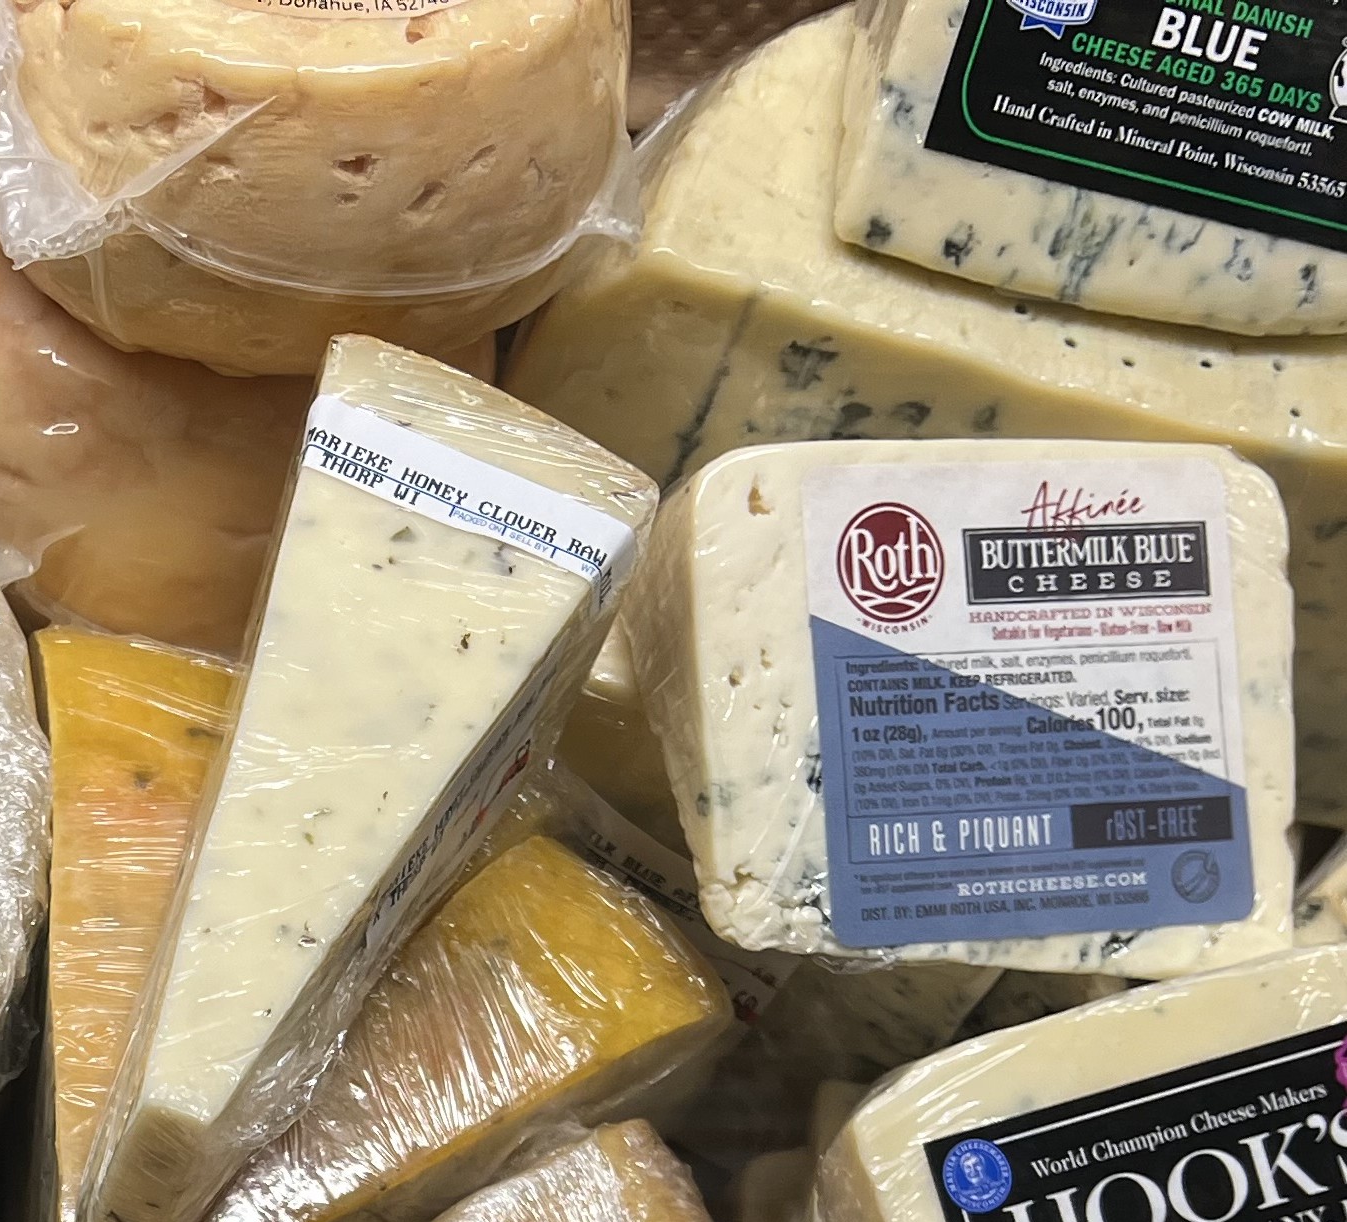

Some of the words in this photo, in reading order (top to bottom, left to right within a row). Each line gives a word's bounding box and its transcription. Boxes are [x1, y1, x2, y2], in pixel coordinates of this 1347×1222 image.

[1152, 6, 1269, 71] BLUE
[1233, 4, 1314, 39] DANISH
[1039, 51, 1118, 85] Ingredients:
[1119, 73, 1178, 99] Cultured
[1177, 90, 1257, 119] pasteurized
[1257, 107, 1296, 129] COW
[1294, 117, 1335, 142] MILK,
[1071, 33, 1157, 71] CHEESE
[1155, 55, 1216, 85] AGED
[1220, 70, 1264, 98] 365
[1267, 82, 1323, 113] DAYS
[992, 95, 1037, 120] Hand
[1038, 106, 1096, 135] Crafted
[1096, 120, 1113, 140] in
[1114, 125, 1176, 155] Mineral
[1175, 141, 1219, 168] Point,
[1224, 152, 1295, 185] Wisconsin
[1297, 171, 1347, 198] 53565
[1046, 79, 1075, 98] salt,
[1077, 87, 1139, 114] enzymes,
[1141, 103, 1171, 120] and
[1169, 110, 1243, 139] penicillium
[1244, 129, 1313, 157] roqueforti.
[319, 452, 384, 489] THORP
[393, 483, 421, 506] WI
[400, 466, 469, 506] HONEY
[478, 501, 557, 544] CLOVER
[566, 537, 608, 566] RAW
[1021, 480, 1147, 540] Affinée
[849, 515, 939, 595] Roth
[979, 535, 1131, 570] BUTTERMILK
[1133, 533, 1196, 565] BLUE
[1008, 570, 1173, 594] CHEESE
[849, 695, 938, 717] Nutrition
[944, 692, 1000, 713] Facts
[1113, 688, 1154, 706] Serv.
[1155, 686, 1191, 704] size:
[1027, 715, 1095, 734] Calories
[1095, 706, 1144, 734] 100,
[851, 726, 860, 743] 1
[862, 728, 881, 743] oz
[882, 723, 928, 745] (28g),
[869, 821, 920, 856] RICH
[931, 820, 948, 853] &
[958, 813, 1052, 852] PIQUANT
[957, 871, 1148, 897] ROTHCHEESE.COM
[1030, 1147, 1089, 1178] World
[1091, 1123, 1189, 1162] Champion
[1190, 1104, 1257, 1134] Cheese
[1259, 1084, 1328, 1115] Makers
